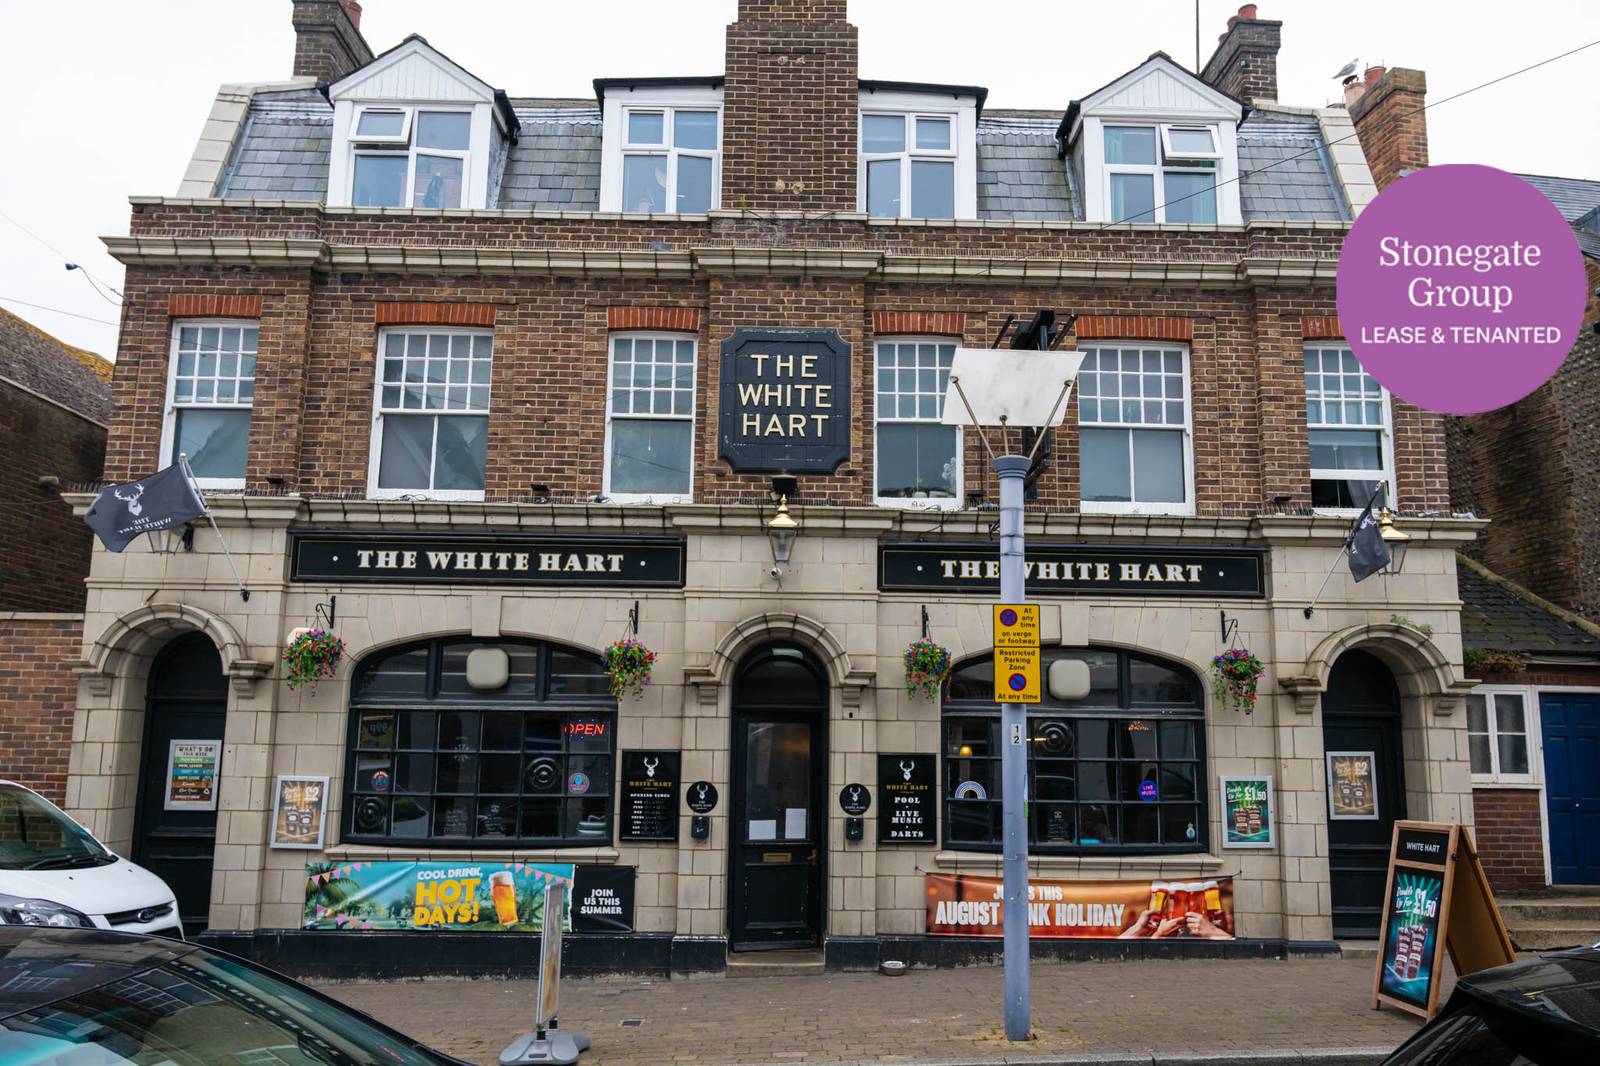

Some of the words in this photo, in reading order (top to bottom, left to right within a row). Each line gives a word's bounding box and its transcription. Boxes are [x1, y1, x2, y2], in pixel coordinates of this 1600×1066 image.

[750, 354, 818, 378] THE
[738, 383, 832, 408] WHITE
[742, 413, 829, 438] HART
[357, 550, 417, 569] THE
[426, 551, 530, 571] WHITE
[538, 553, 625, 573] HART
[940, 559, 1000, 579] THE
[1119, 563, 1203, 583] HART
[563, 723, 605, 736] OPEN
[1406, 841, 1425, 851] WHITE
[1424, 844, 1440, 854] HART
[417, 871, 447, 881] COOL
[447, 867, 484, 880] DRINK,
[416, 878, 482, 906] HOT
[583, 897, 597, 906] US
[598, 896, 621, 906] THIS
[591, 888, 614, 898] JOIN
[1039, 885, 1063, 901] THIS
[414, 902, 480, 926] DAYS!
[579, 905, 623, 915] SUMMER
[935, 901, 1000, 925] AUGUST
[1028, 903, 1051, 926] NK
[1055, 903, 1124, 927] HOLIDAY
